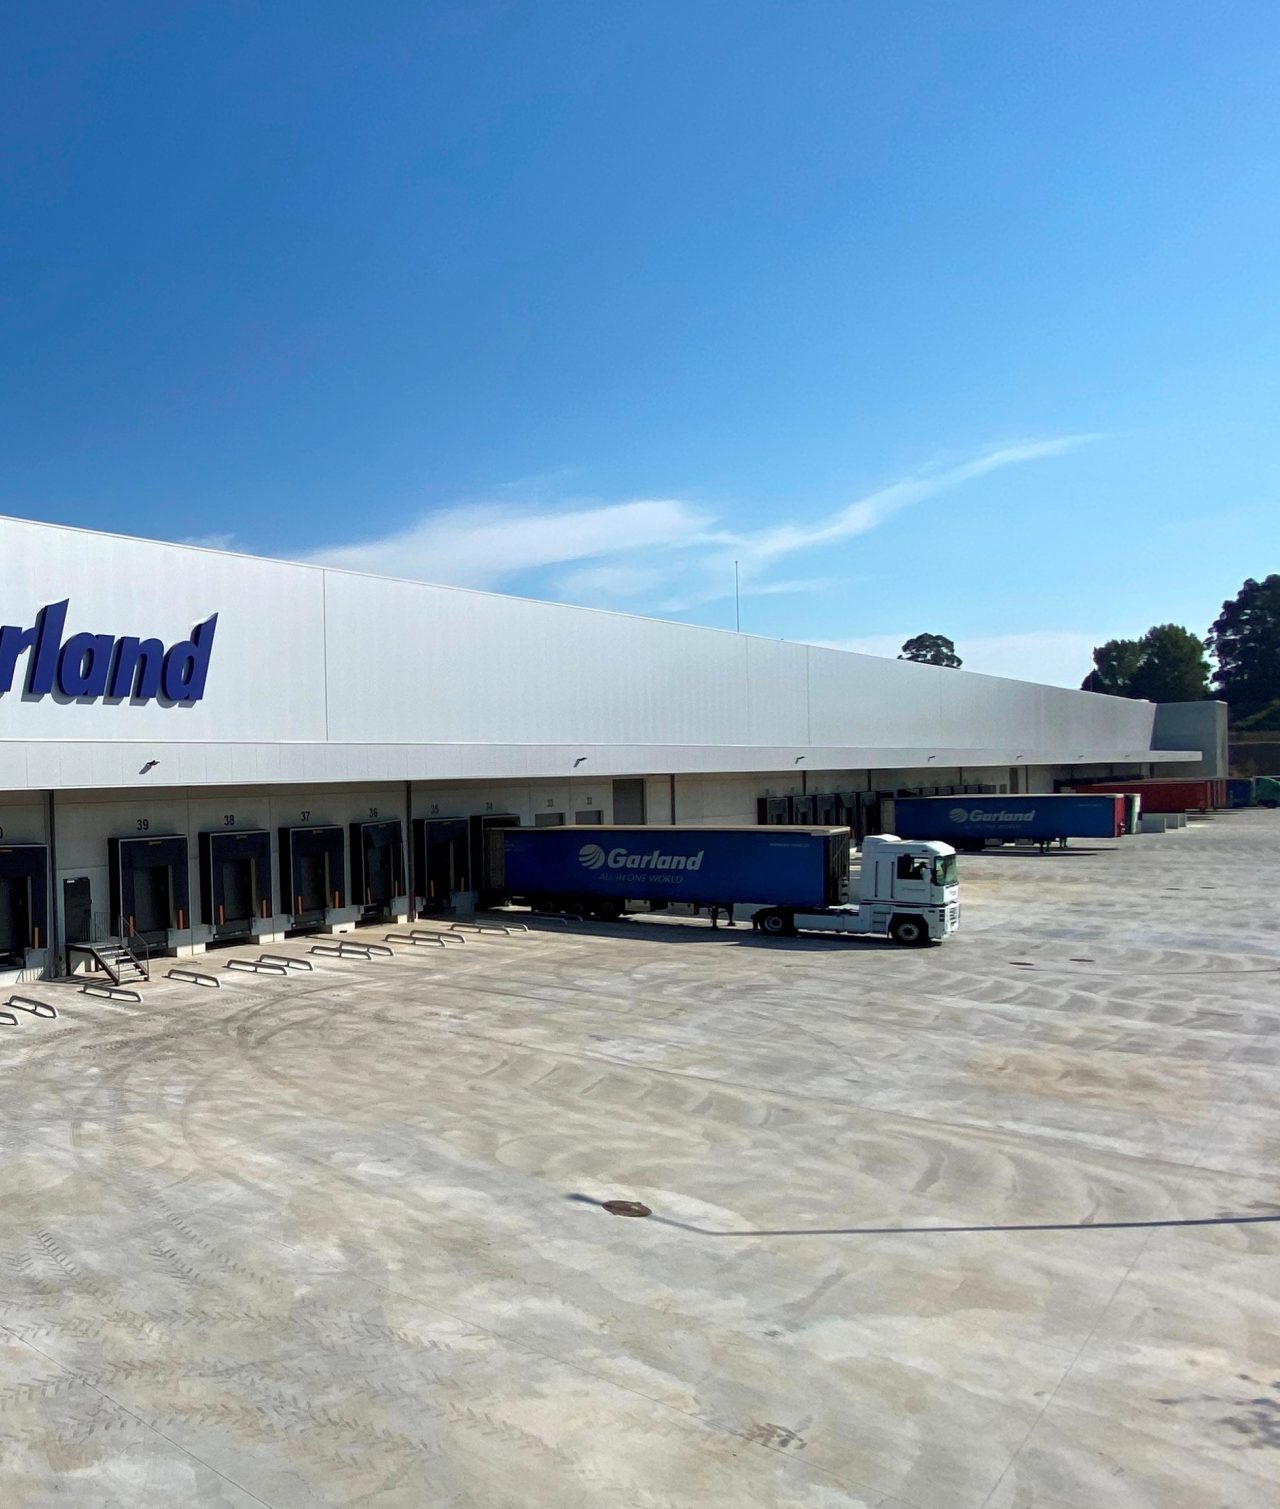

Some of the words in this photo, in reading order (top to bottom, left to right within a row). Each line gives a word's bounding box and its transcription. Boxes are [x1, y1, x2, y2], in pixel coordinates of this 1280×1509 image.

[300, 811, 311, 821] 37
[368, 807, 378, 818] 36
[970, 809, 1036, 822] Garland
[136, 818, 149, 831] 39
[223, 814, 235, 826] 38
[607, 848, 704, 870] Garland
